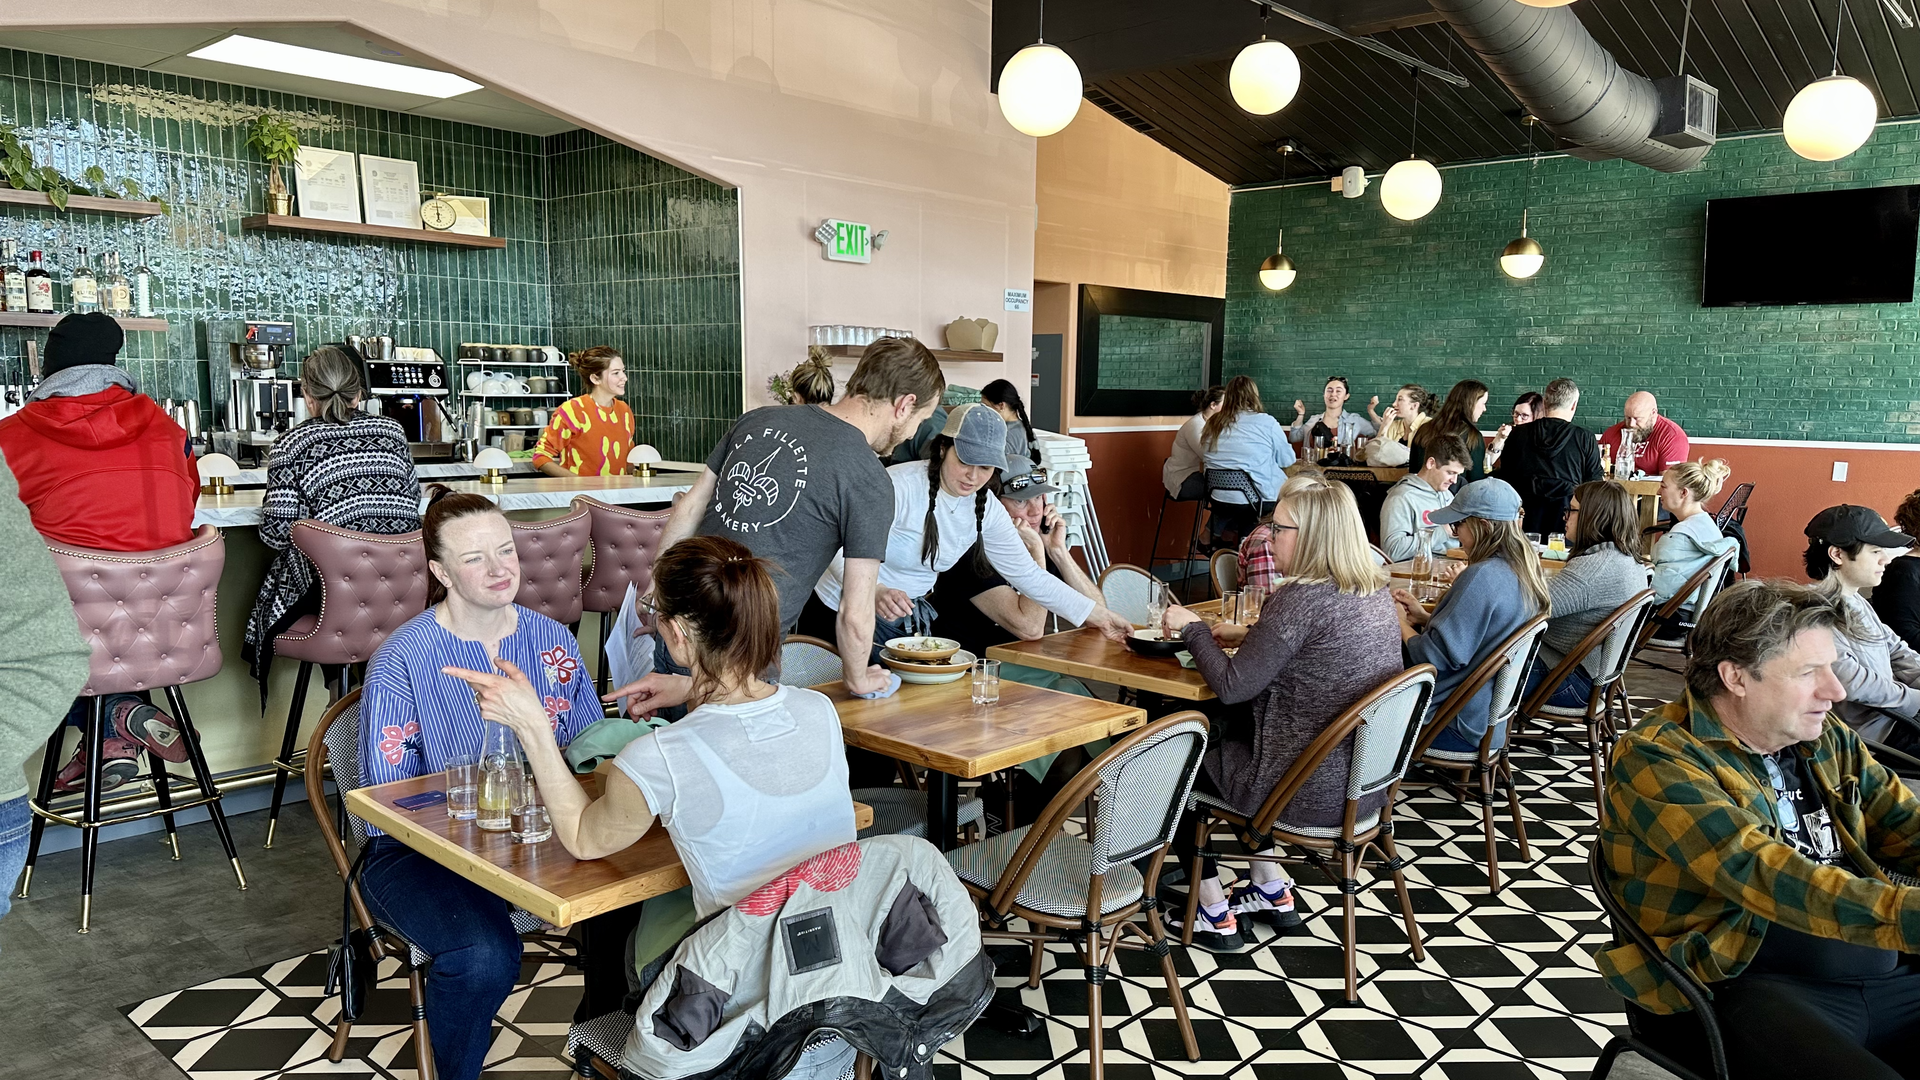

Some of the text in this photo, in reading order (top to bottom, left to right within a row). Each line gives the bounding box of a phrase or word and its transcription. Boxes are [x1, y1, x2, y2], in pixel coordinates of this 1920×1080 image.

[836, 222, 867, 257] EXIT
[734, 428, 808, 489] LA FILLETTE
[715, 502, 760, 532] BAKERY
